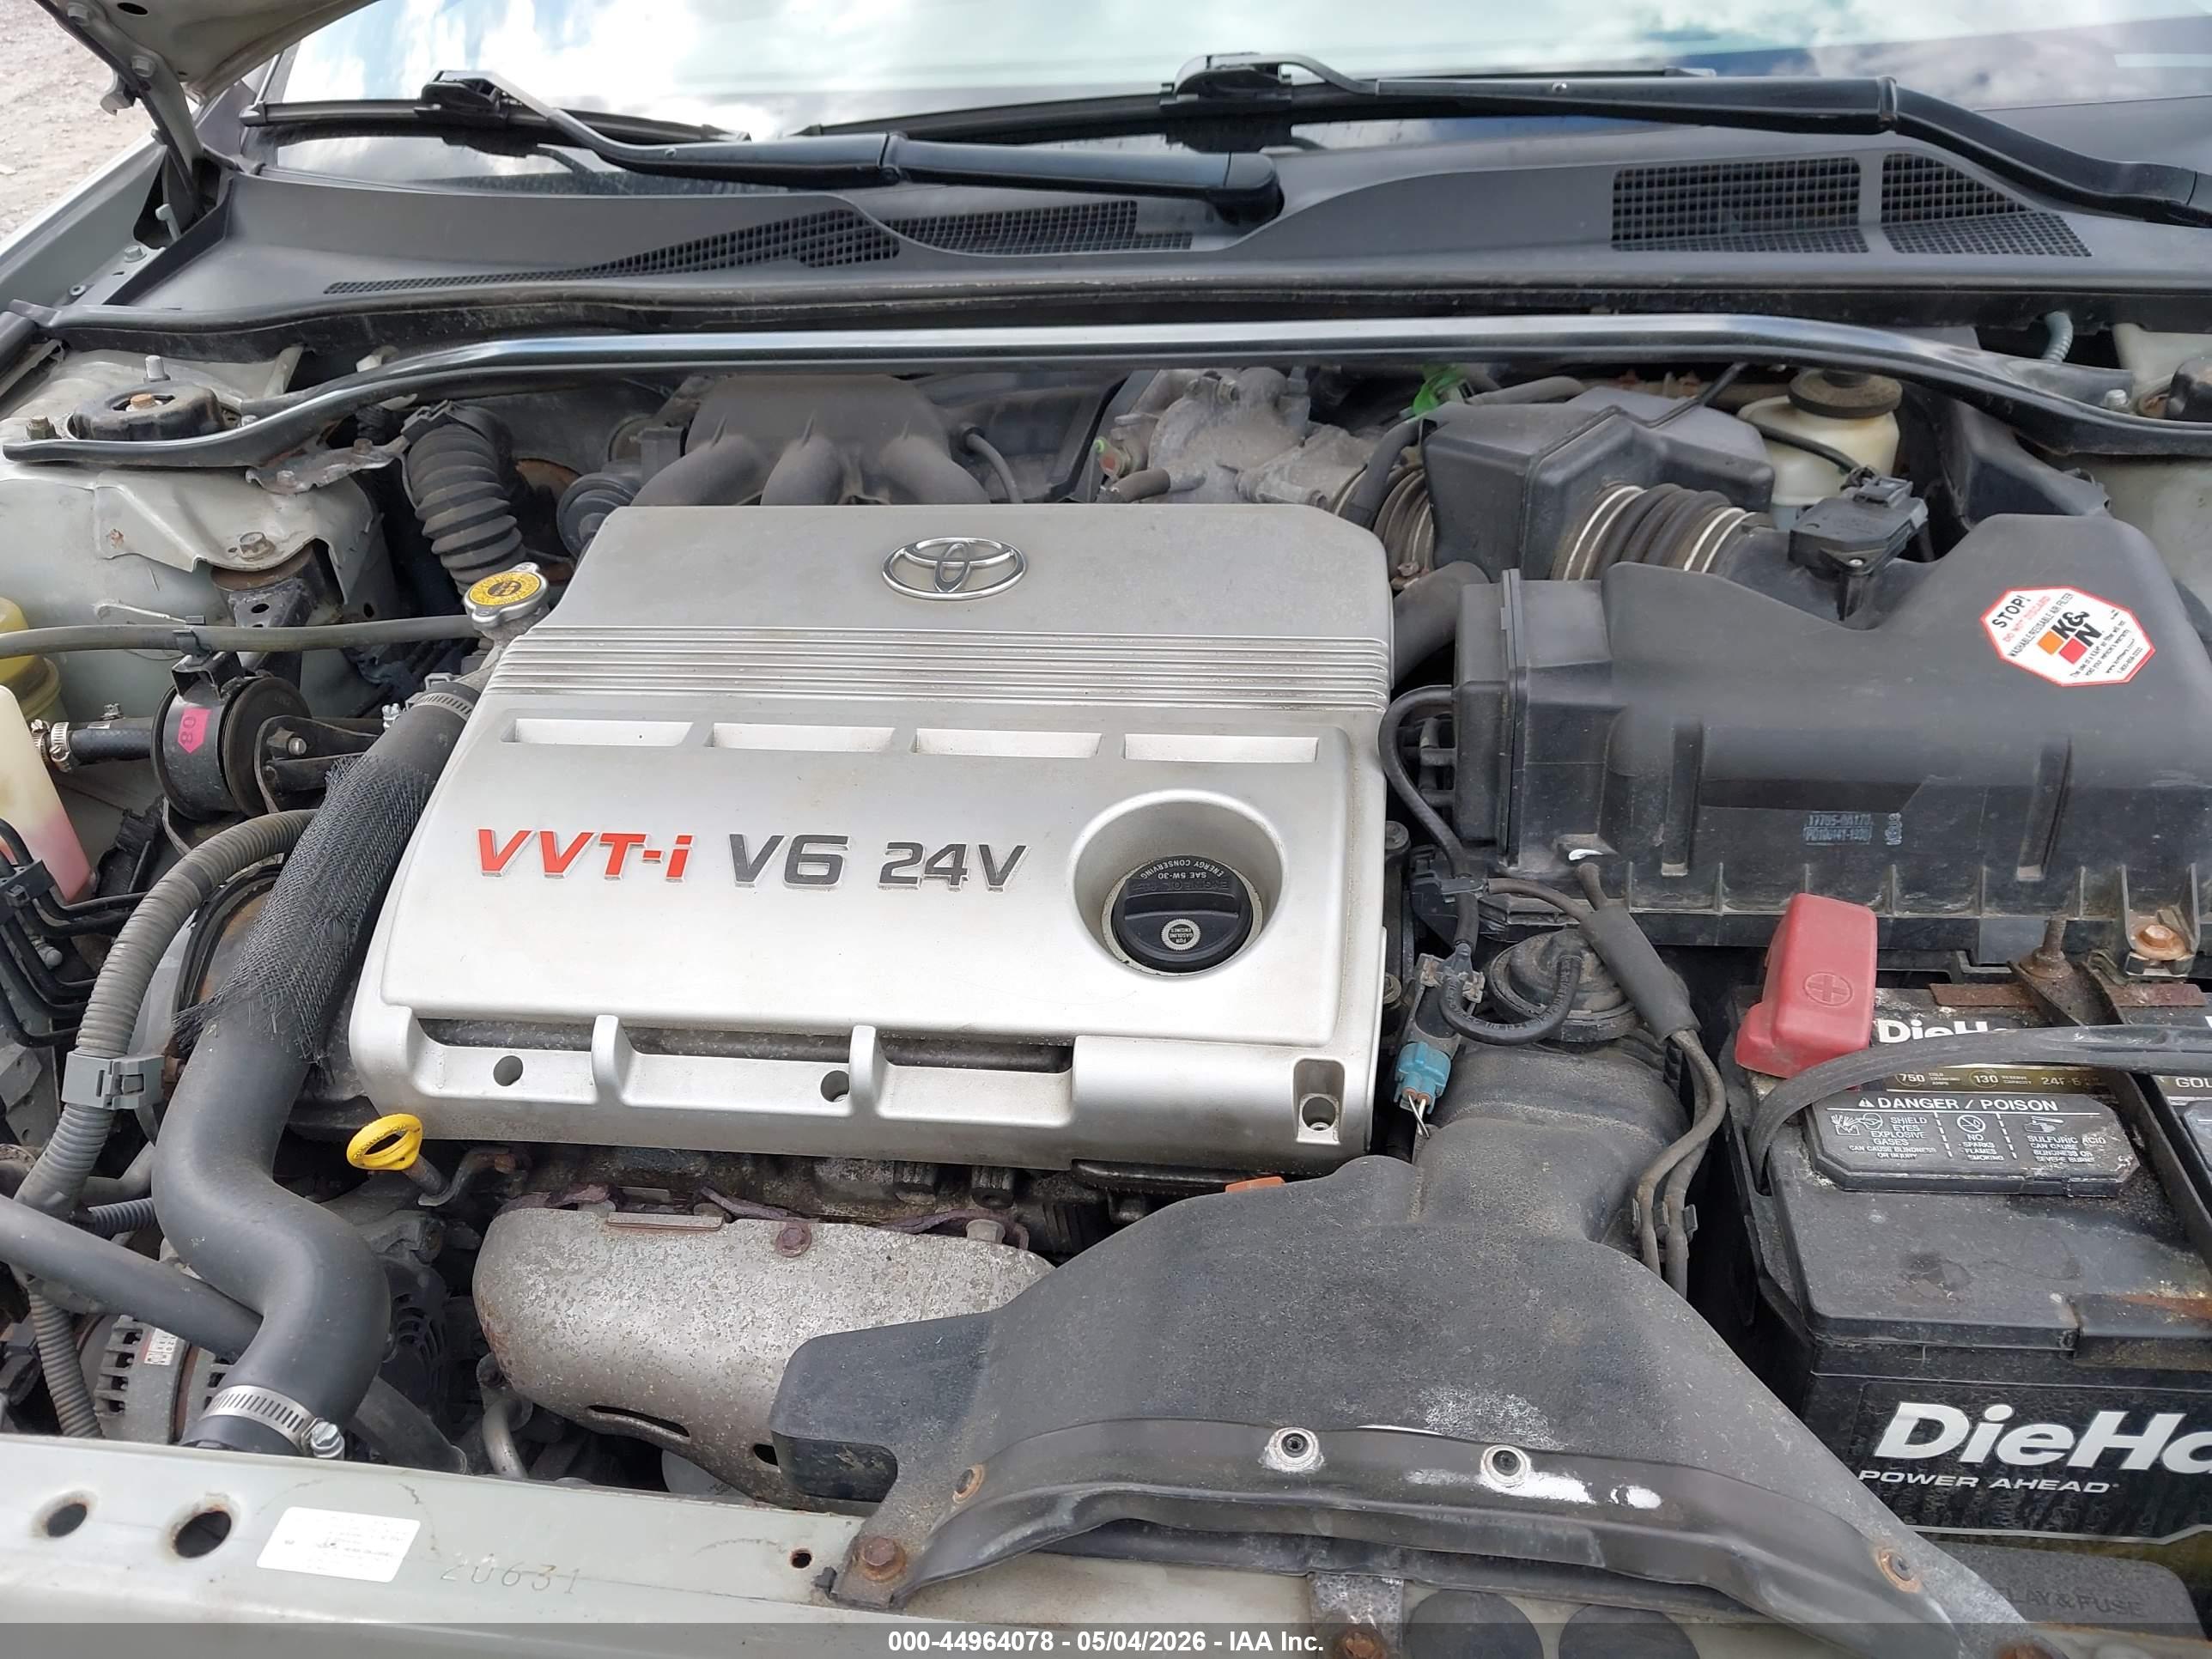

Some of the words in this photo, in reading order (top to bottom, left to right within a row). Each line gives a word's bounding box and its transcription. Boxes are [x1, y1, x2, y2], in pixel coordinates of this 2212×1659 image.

[1992, 595, 2031, 628] STOP!
[476, 828, 696, 884] VVT-i
[728, 831, 854, 890] V6
[876, 841, 1030, 894] 24V
[1194, 860, 1224, 878] ENERGY
[1140, 860, 1191, 879] CONSERVING
[1899, 1073, 1925, 1083] 750
[1973, 1074, 1999, 1085] 130
[2175, 1078, 2212, 1088] GOL
[1877, 1097, 1960, 1109] DANGER
[1980, 1099, 2058, 1111] POISON
[2027, 1135, 2078, 1144] SULFURIC
[2081, 1136, 2106, 1145] ACID
[1858, 1470, 1978, 1488] POWER
